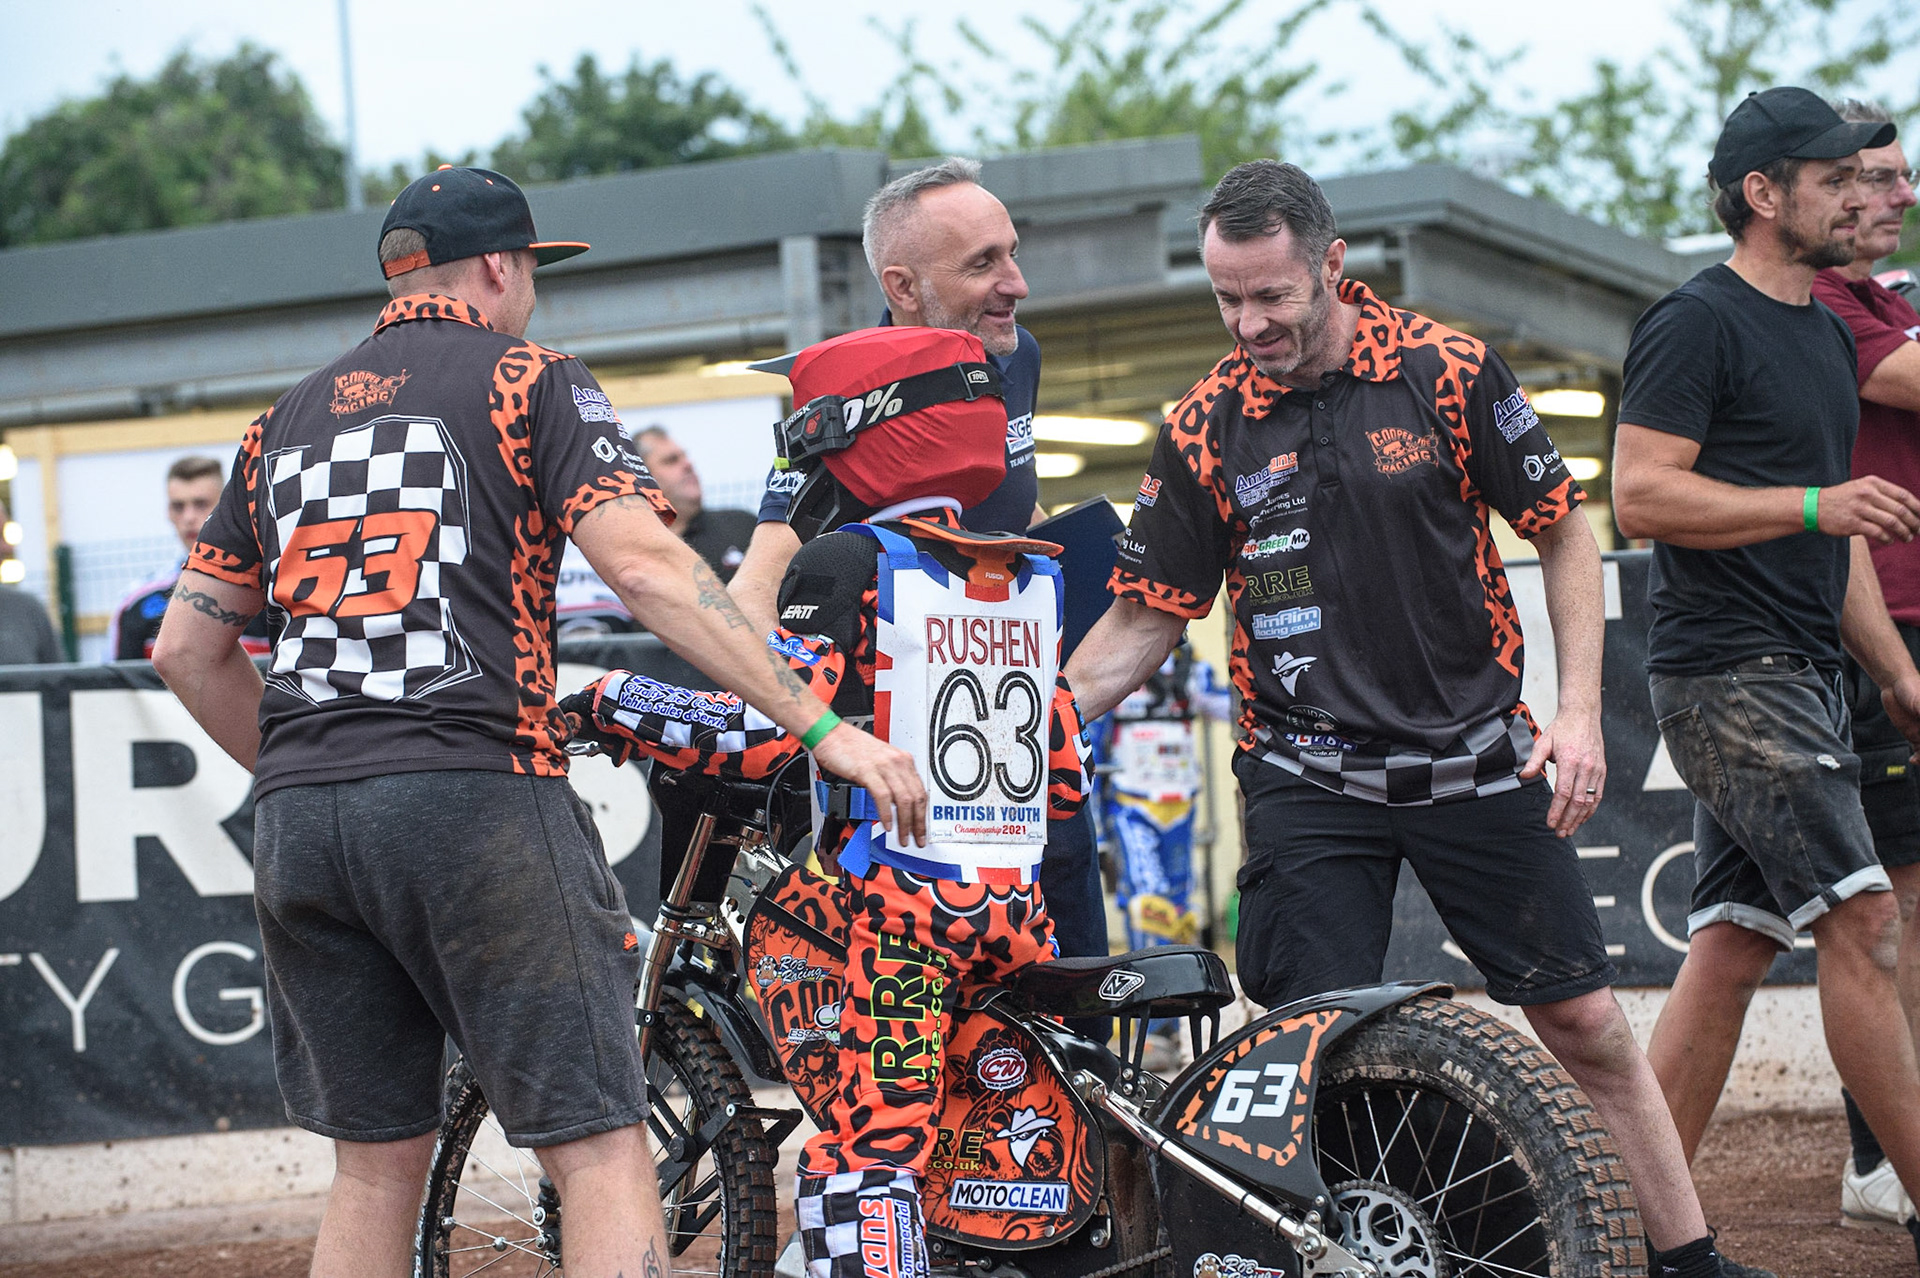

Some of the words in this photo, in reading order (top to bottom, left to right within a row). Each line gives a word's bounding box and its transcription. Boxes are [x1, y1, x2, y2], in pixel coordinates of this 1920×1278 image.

[337, 371, 381, 391] COOPER
[334, 390, 389, 413] RACING
[1016, 417, 1032, 439] GB
[1370, 428, 1414, 447] COOPER
[1382, 450, 1431, 473] RACING
[1292, 496, 1307, 506] Ltd
[1129, 540, 1147, 555] Ltd
[272, 510, 438, 618] 63
[985, 571, 1005, 581] FUSION
[1246, 565, 1312, 598] RRE
[926, 617, 1041, 669] RUSHEN
[652, 701, 683, 718] Sales
[929, 668, 1044, 804] 63
[933, 805, 995, 822] BRITISH
[1000, 806, 1041, 823] YOUTH
[1002, 825, 1027, 836] 2021
[780, 954, 808, 970] ROB
[781, 967, 822, 986] Racing
[870, 930, 927, 1083] RRE
[1439, 1059, 1500, 1106] ANLAS
[1211, 1063, 1300, 1124] 63
[932, 1127, 985, 1161] RE
[1224, 1256, 1258, 1275] ROB
